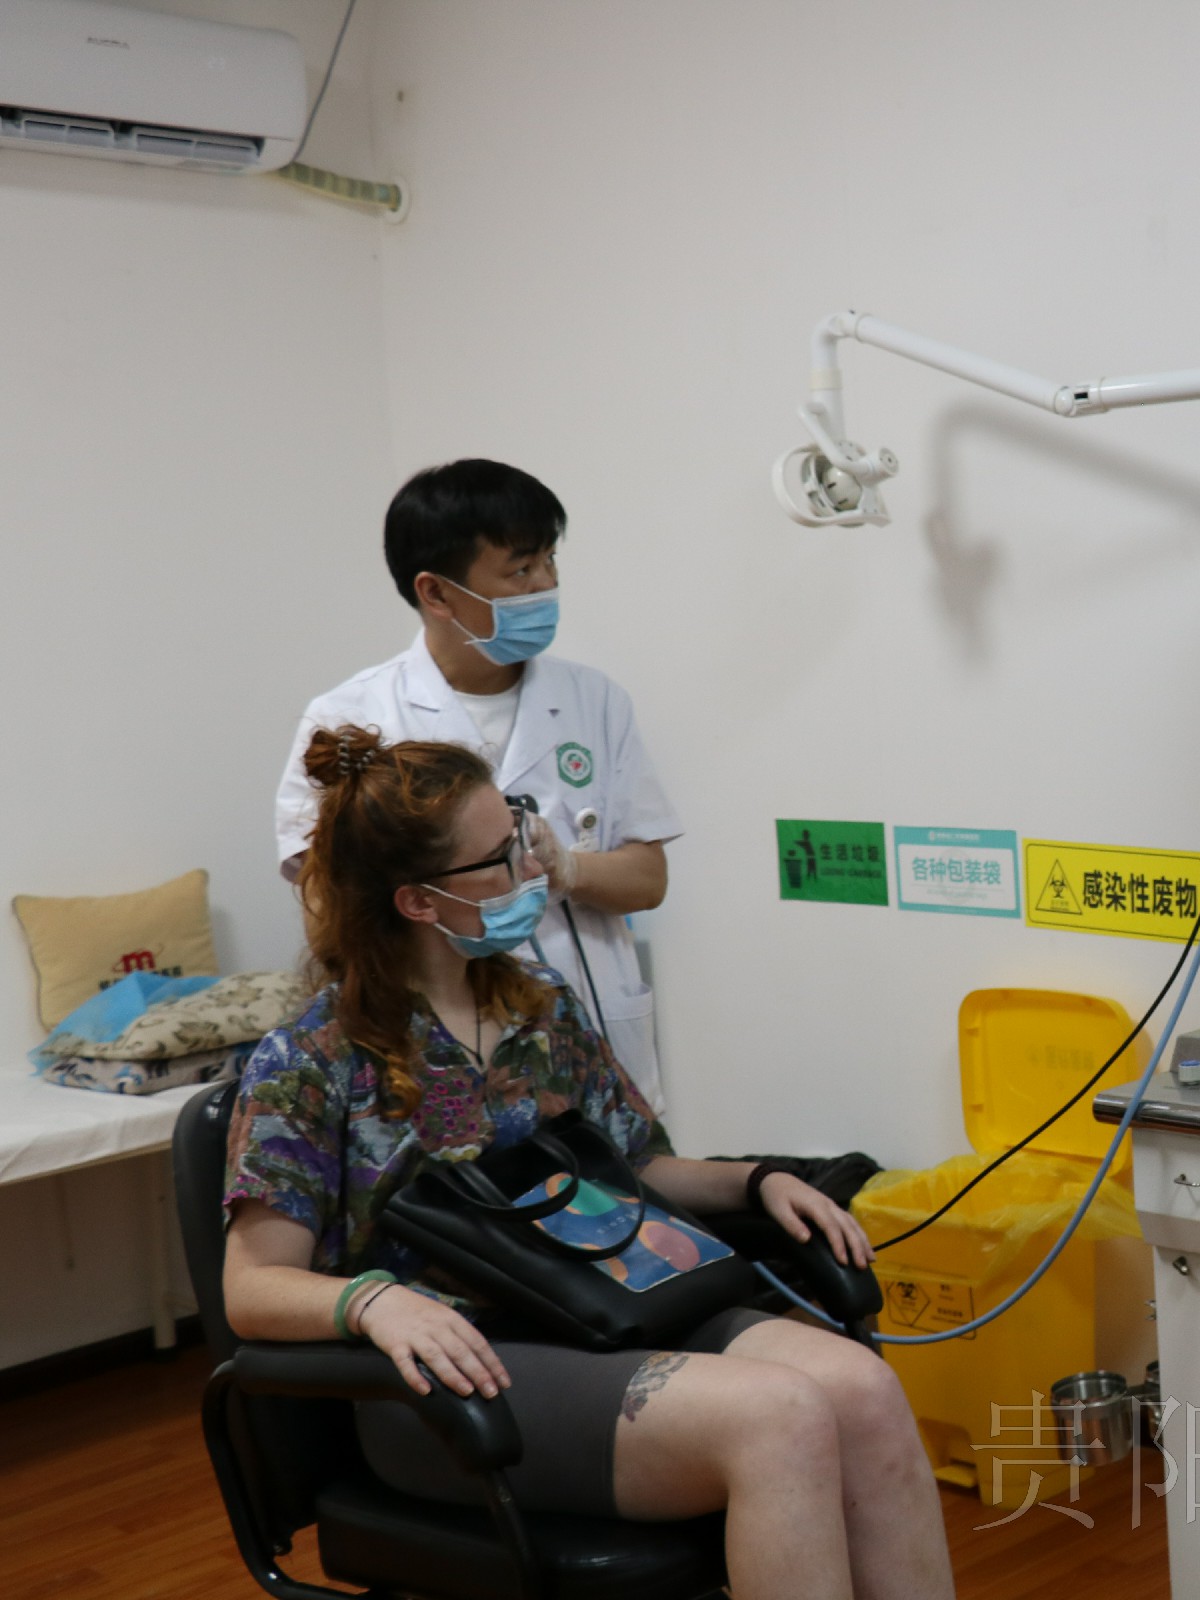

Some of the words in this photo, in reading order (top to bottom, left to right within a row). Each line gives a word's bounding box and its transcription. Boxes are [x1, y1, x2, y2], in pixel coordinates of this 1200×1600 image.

[820, 843, 880, 862] 生活垃圾
[912, 856, 1002, 885] 各种包装袋
[1083, 868, 1198, 919] 感染性废物
